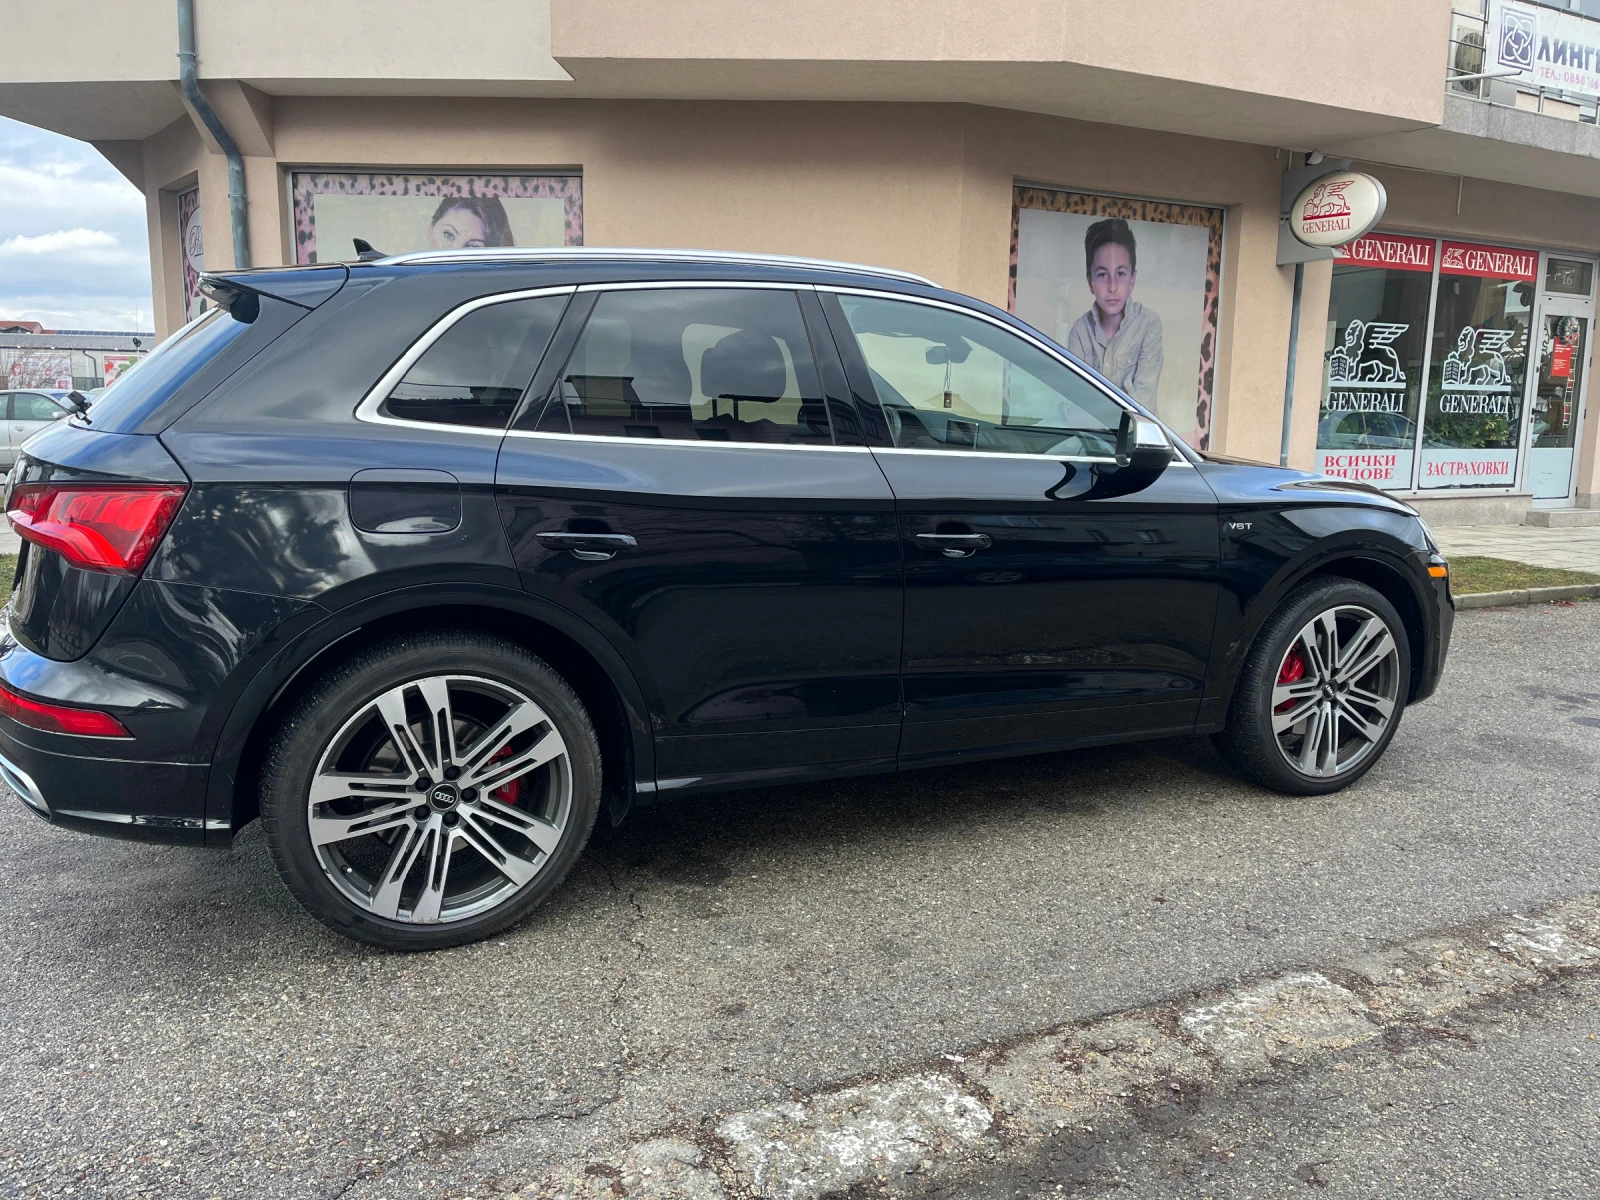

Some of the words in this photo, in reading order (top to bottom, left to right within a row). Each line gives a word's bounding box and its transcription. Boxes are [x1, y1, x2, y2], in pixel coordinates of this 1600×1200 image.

[1303, 218, 1351, 234] GENERALI
[1352, 239, 1430, 265] GENERALI
[1465, 250, 1534, 276] GENERALI
[1326, 392, 1405, 412] GENERALI
[1440, 394, 1510, 414] GENERALI
[1324, 455, 1396, 468] ВСИЧКИ
[1426, 461, 1509, 476] ЗАСТРАХОВКИ
